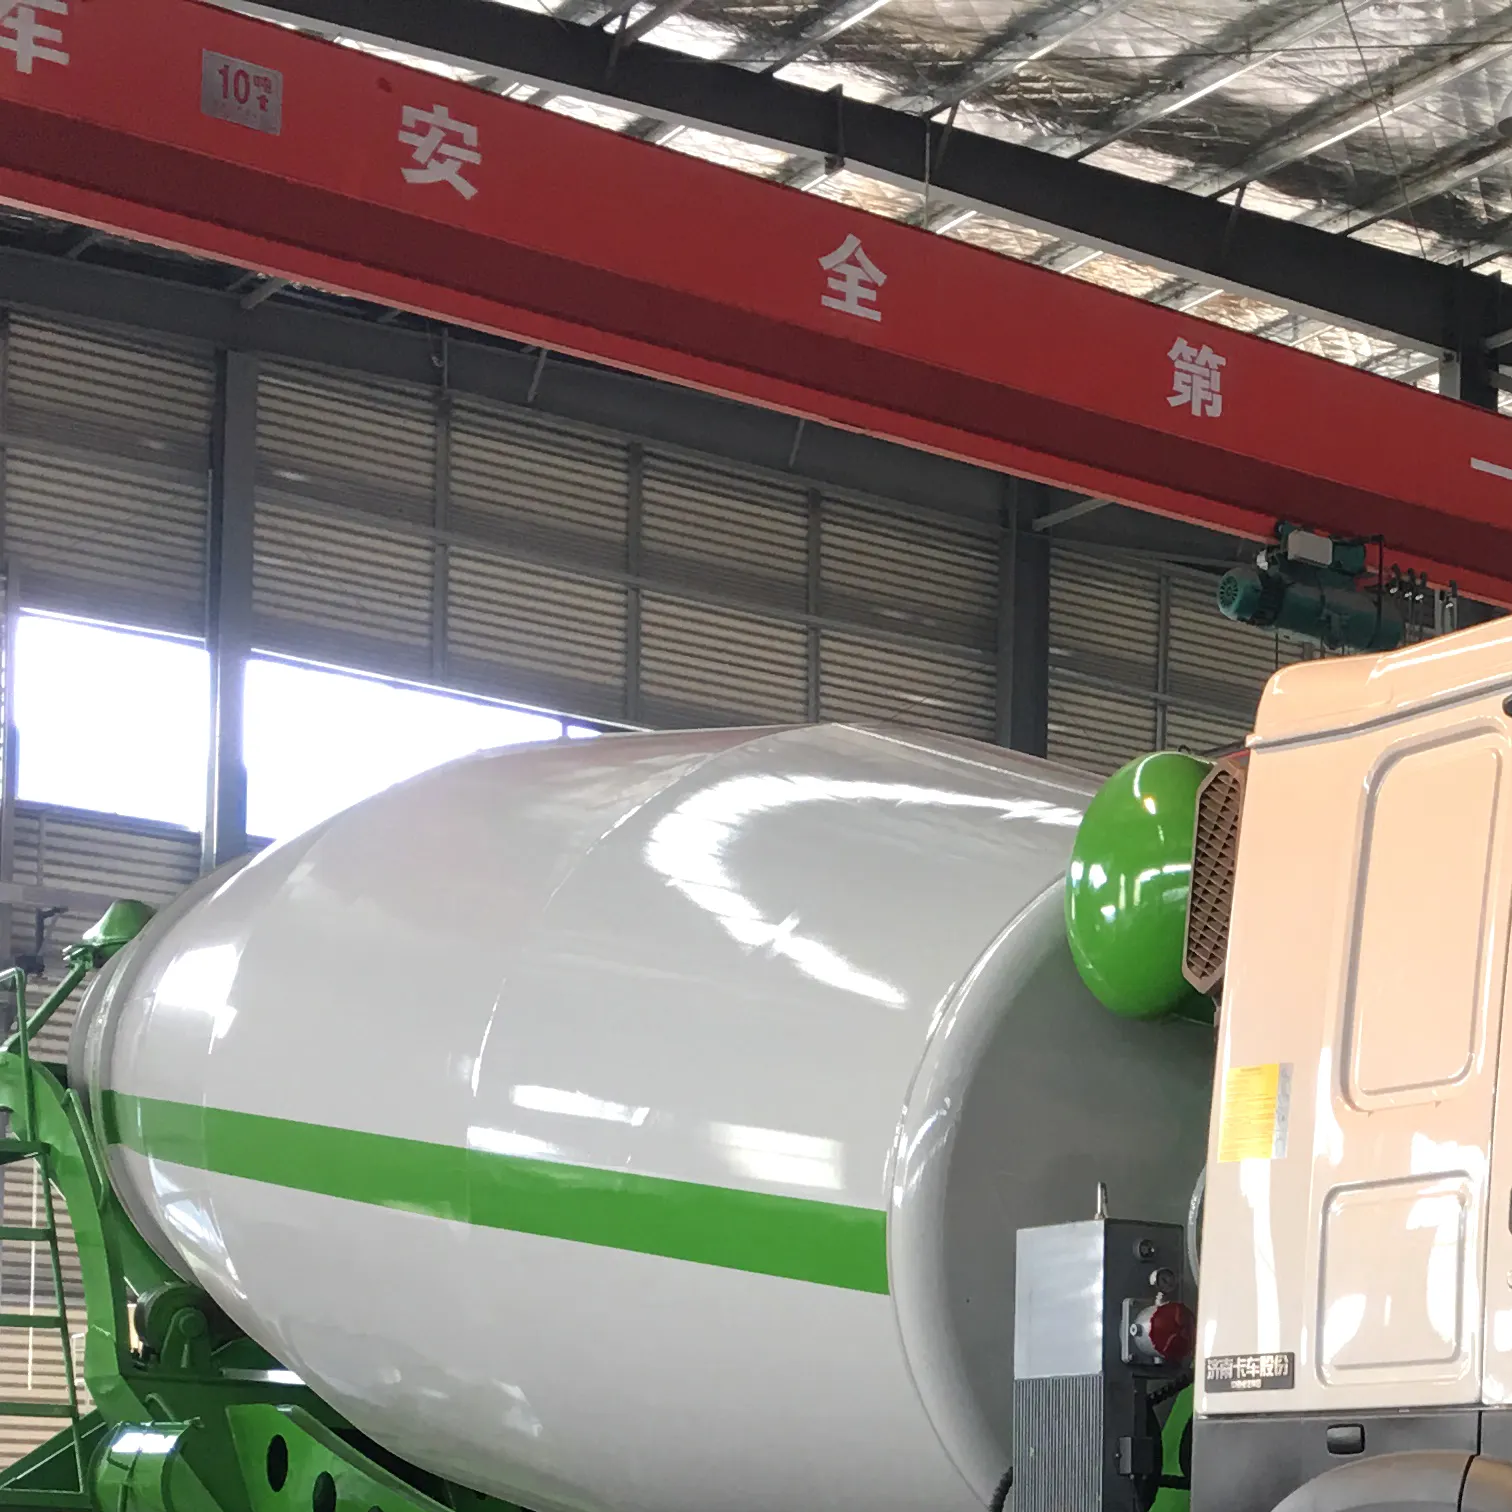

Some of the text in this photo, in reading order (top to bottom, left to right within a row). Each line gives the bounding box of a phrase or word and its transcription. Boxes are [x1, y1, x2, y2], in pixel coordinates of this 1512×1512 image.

[217, 63, 250, 105] 10
[398, 103, 482, 200] 安
[817, 233, 888, 322] 全
[1166, 336, 1228, 418] 第
[1206, 1354, 1289, 1380] 济南卡车股份
